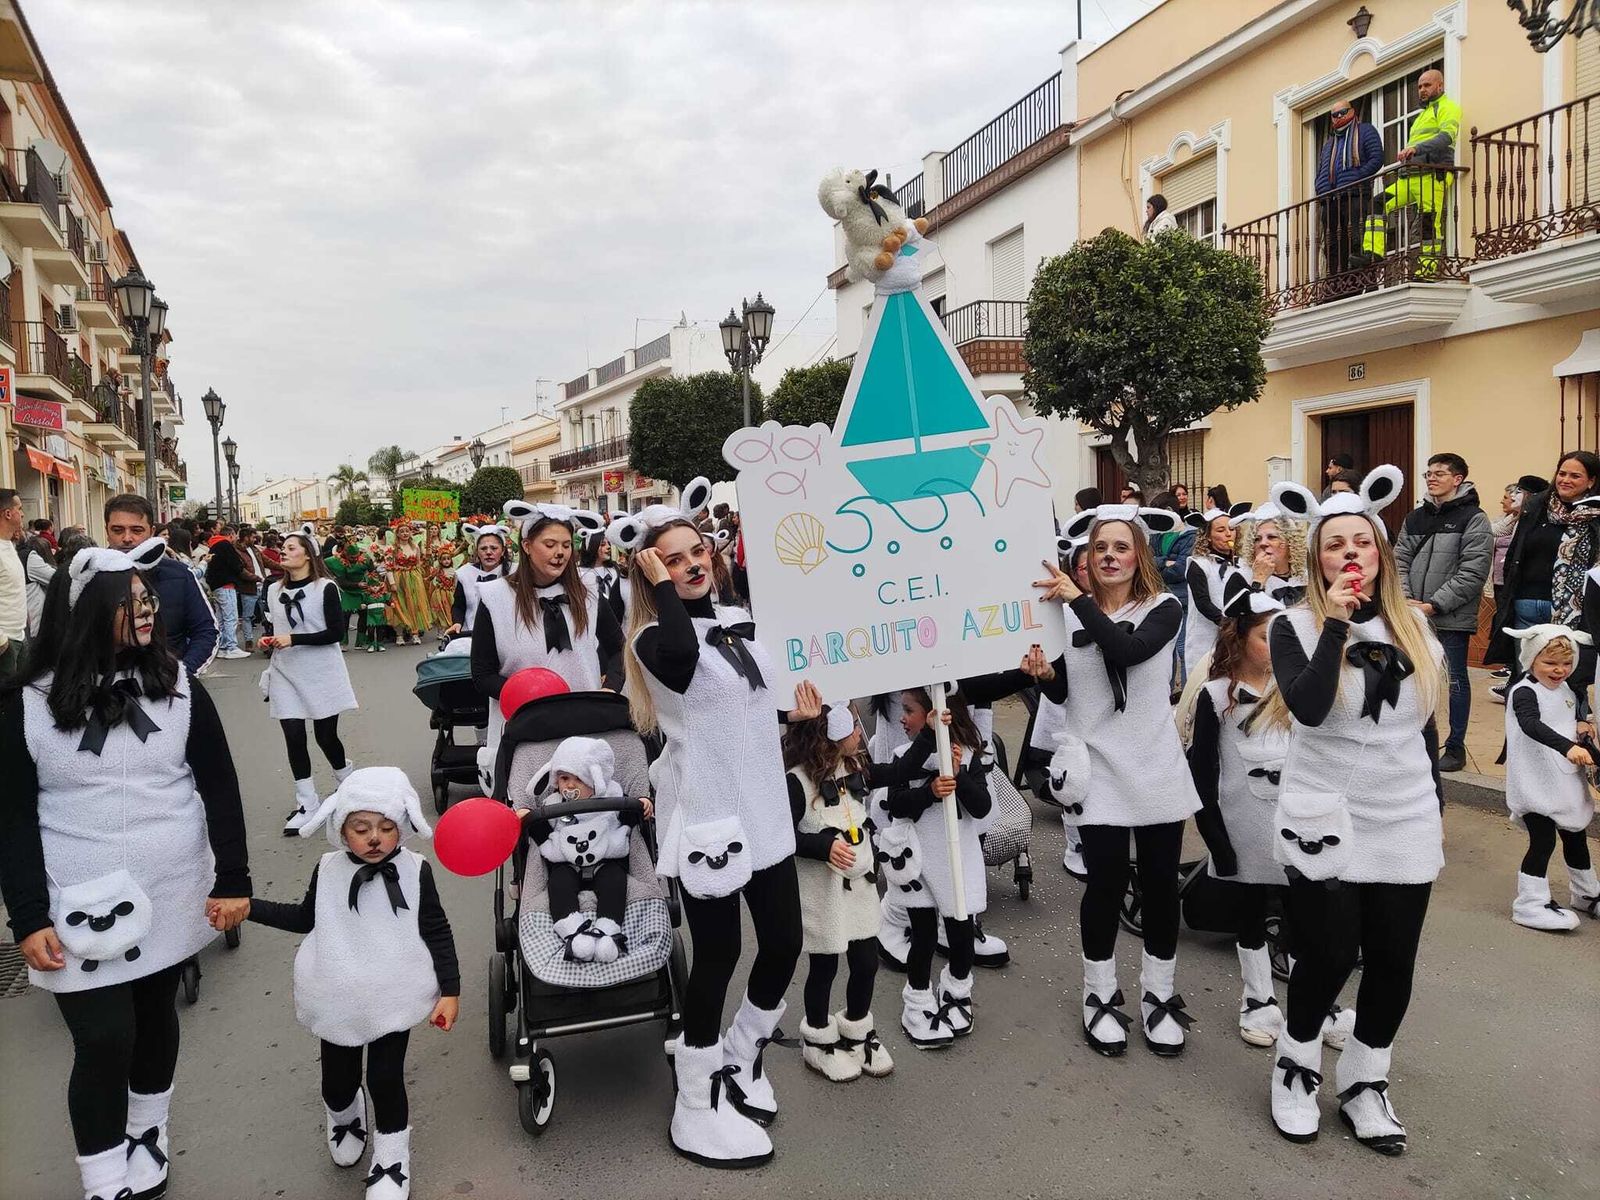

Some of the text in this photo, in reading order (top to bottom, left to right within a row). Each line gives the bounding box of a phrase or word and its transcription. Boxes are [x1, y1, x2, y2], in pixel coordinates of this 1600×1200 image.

[1351, 365, 1362, 378] 86
[877, 574, 949, 605] C.E.I.
[786, 599, 1043, 672] BARQUITO AZUL
